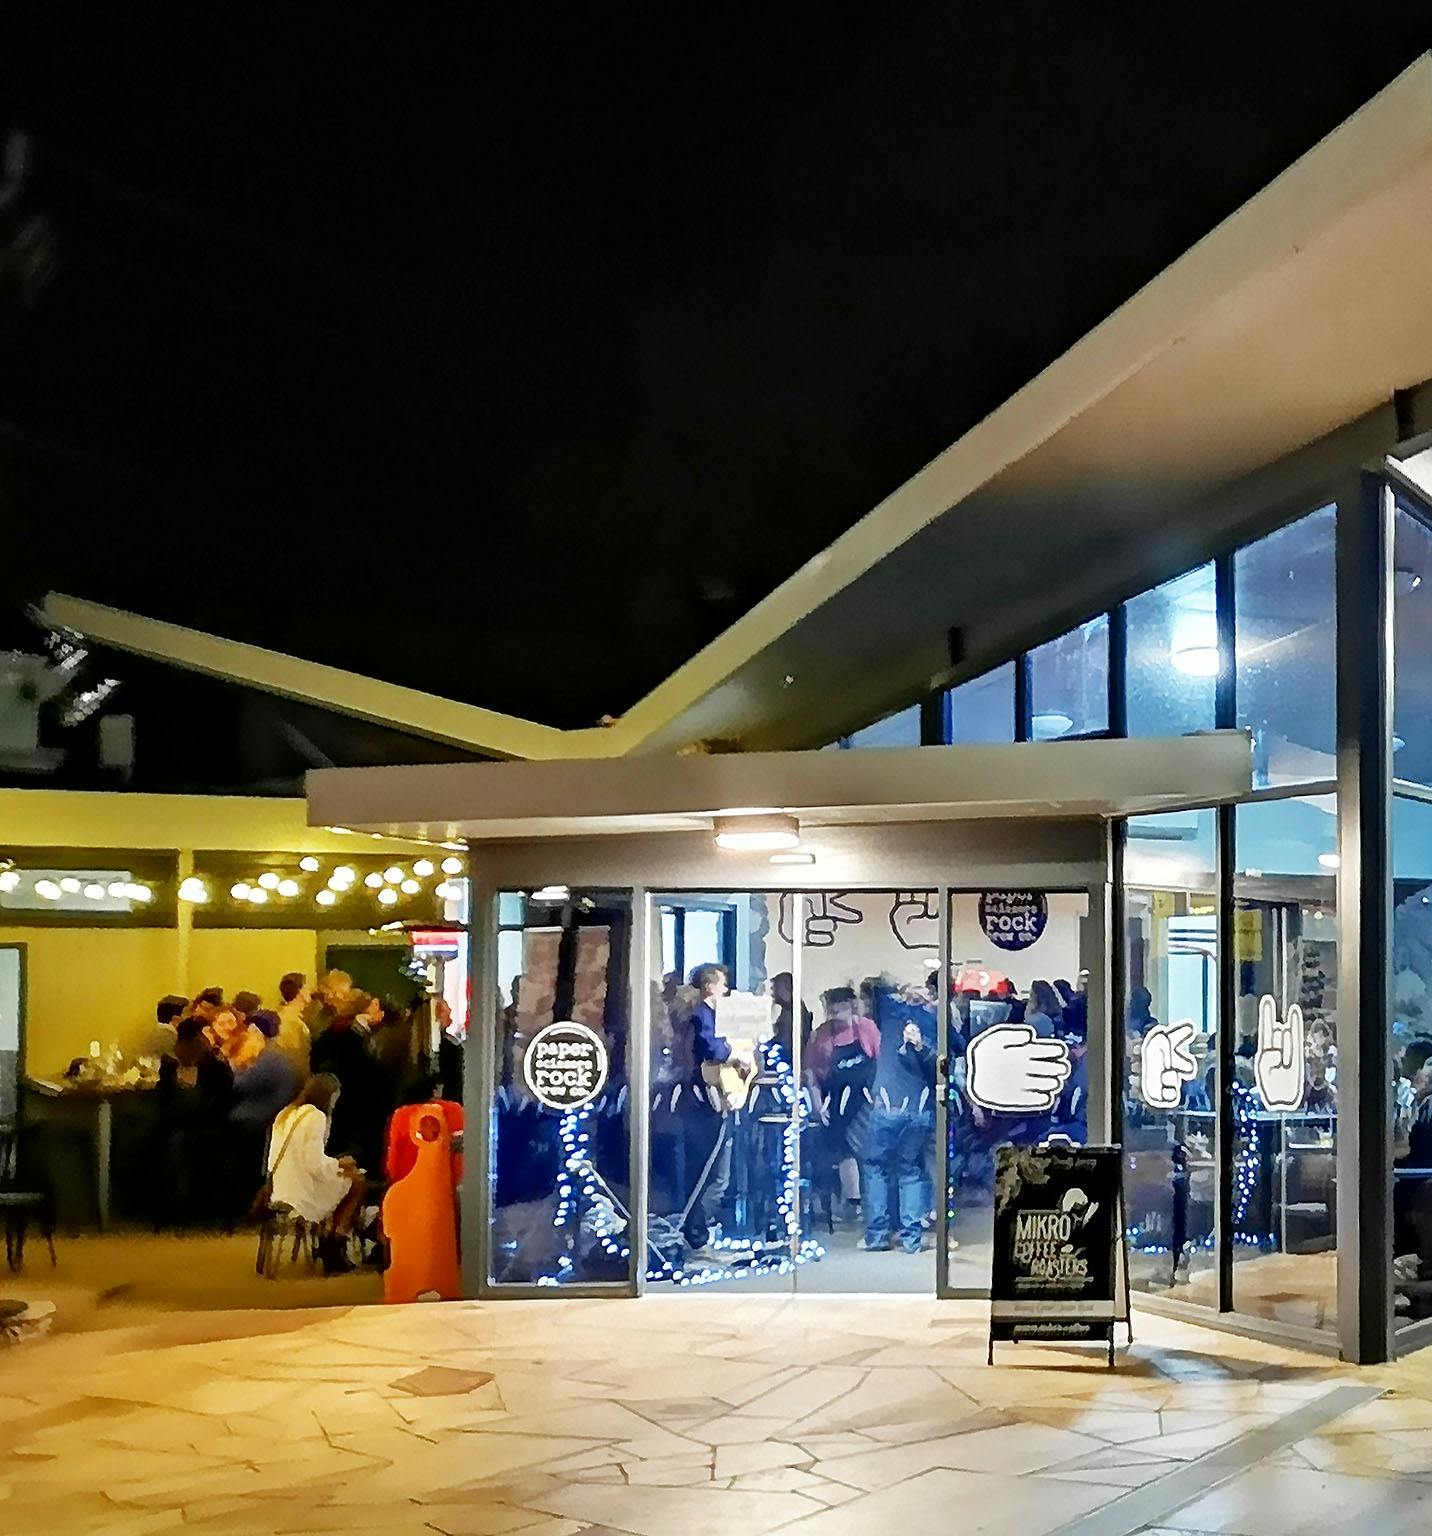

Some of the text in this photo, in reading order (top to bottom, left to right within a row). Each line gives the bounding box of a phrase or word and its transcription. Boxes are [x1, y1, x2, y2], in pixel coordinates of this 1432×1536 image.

[986, 911, 1038, 932] rock
[536, 1042, 593, 1059] paper
[535, 1066, 592, 1087] rock
[1016, 1214, 1071, 1241] MIKRO
